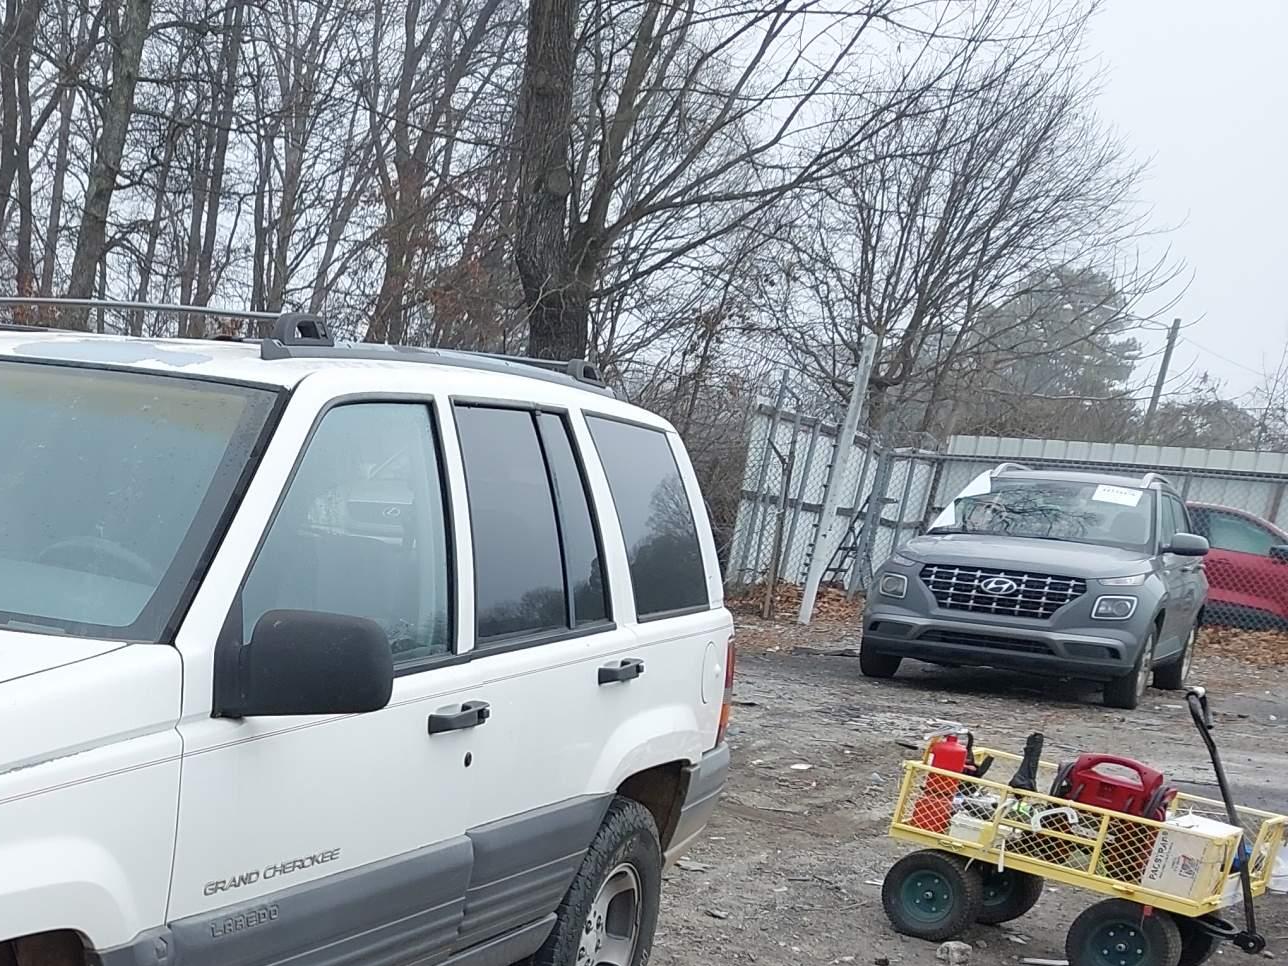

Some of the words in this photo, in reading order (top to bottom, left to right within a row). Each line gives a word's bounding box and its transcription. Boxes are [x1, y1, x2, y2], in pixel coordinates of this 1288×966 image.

[203, 870, 260, 897] GRAND
[263, 847, 341, 880] CHEROKEE
[210, 904, 280, 938] LAREDO
